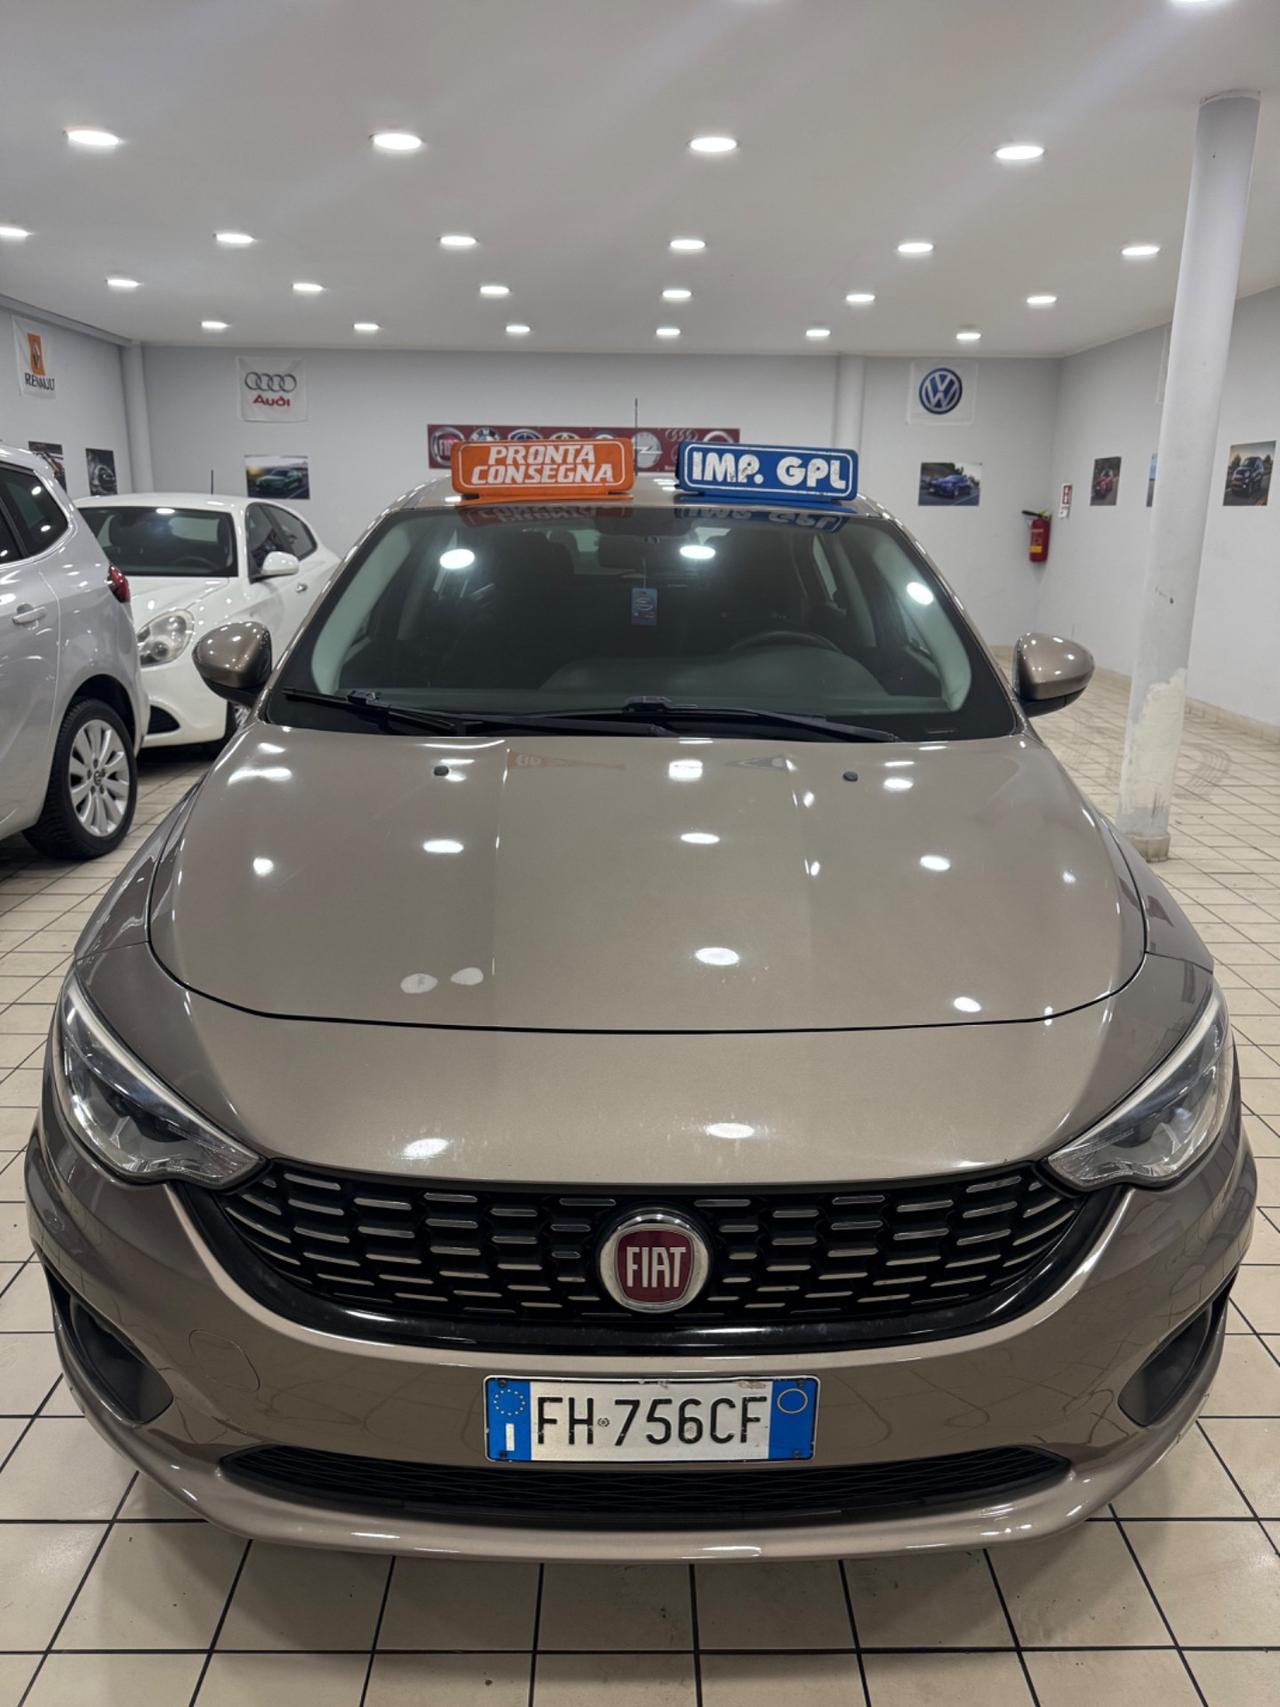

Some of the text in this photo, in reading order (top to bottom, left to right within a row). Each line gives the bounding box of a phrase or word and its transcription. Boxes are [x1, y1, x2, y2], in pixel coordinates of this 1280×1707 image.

[252, 394, 291, 407] Audi
[488, 445, 596, 465] PRONTA
[471, 464, 615, 485] CONSEGNA
[692, 451, 846, 489] IMP. GPL
[626, 1247, 687, 1288] FIAT
